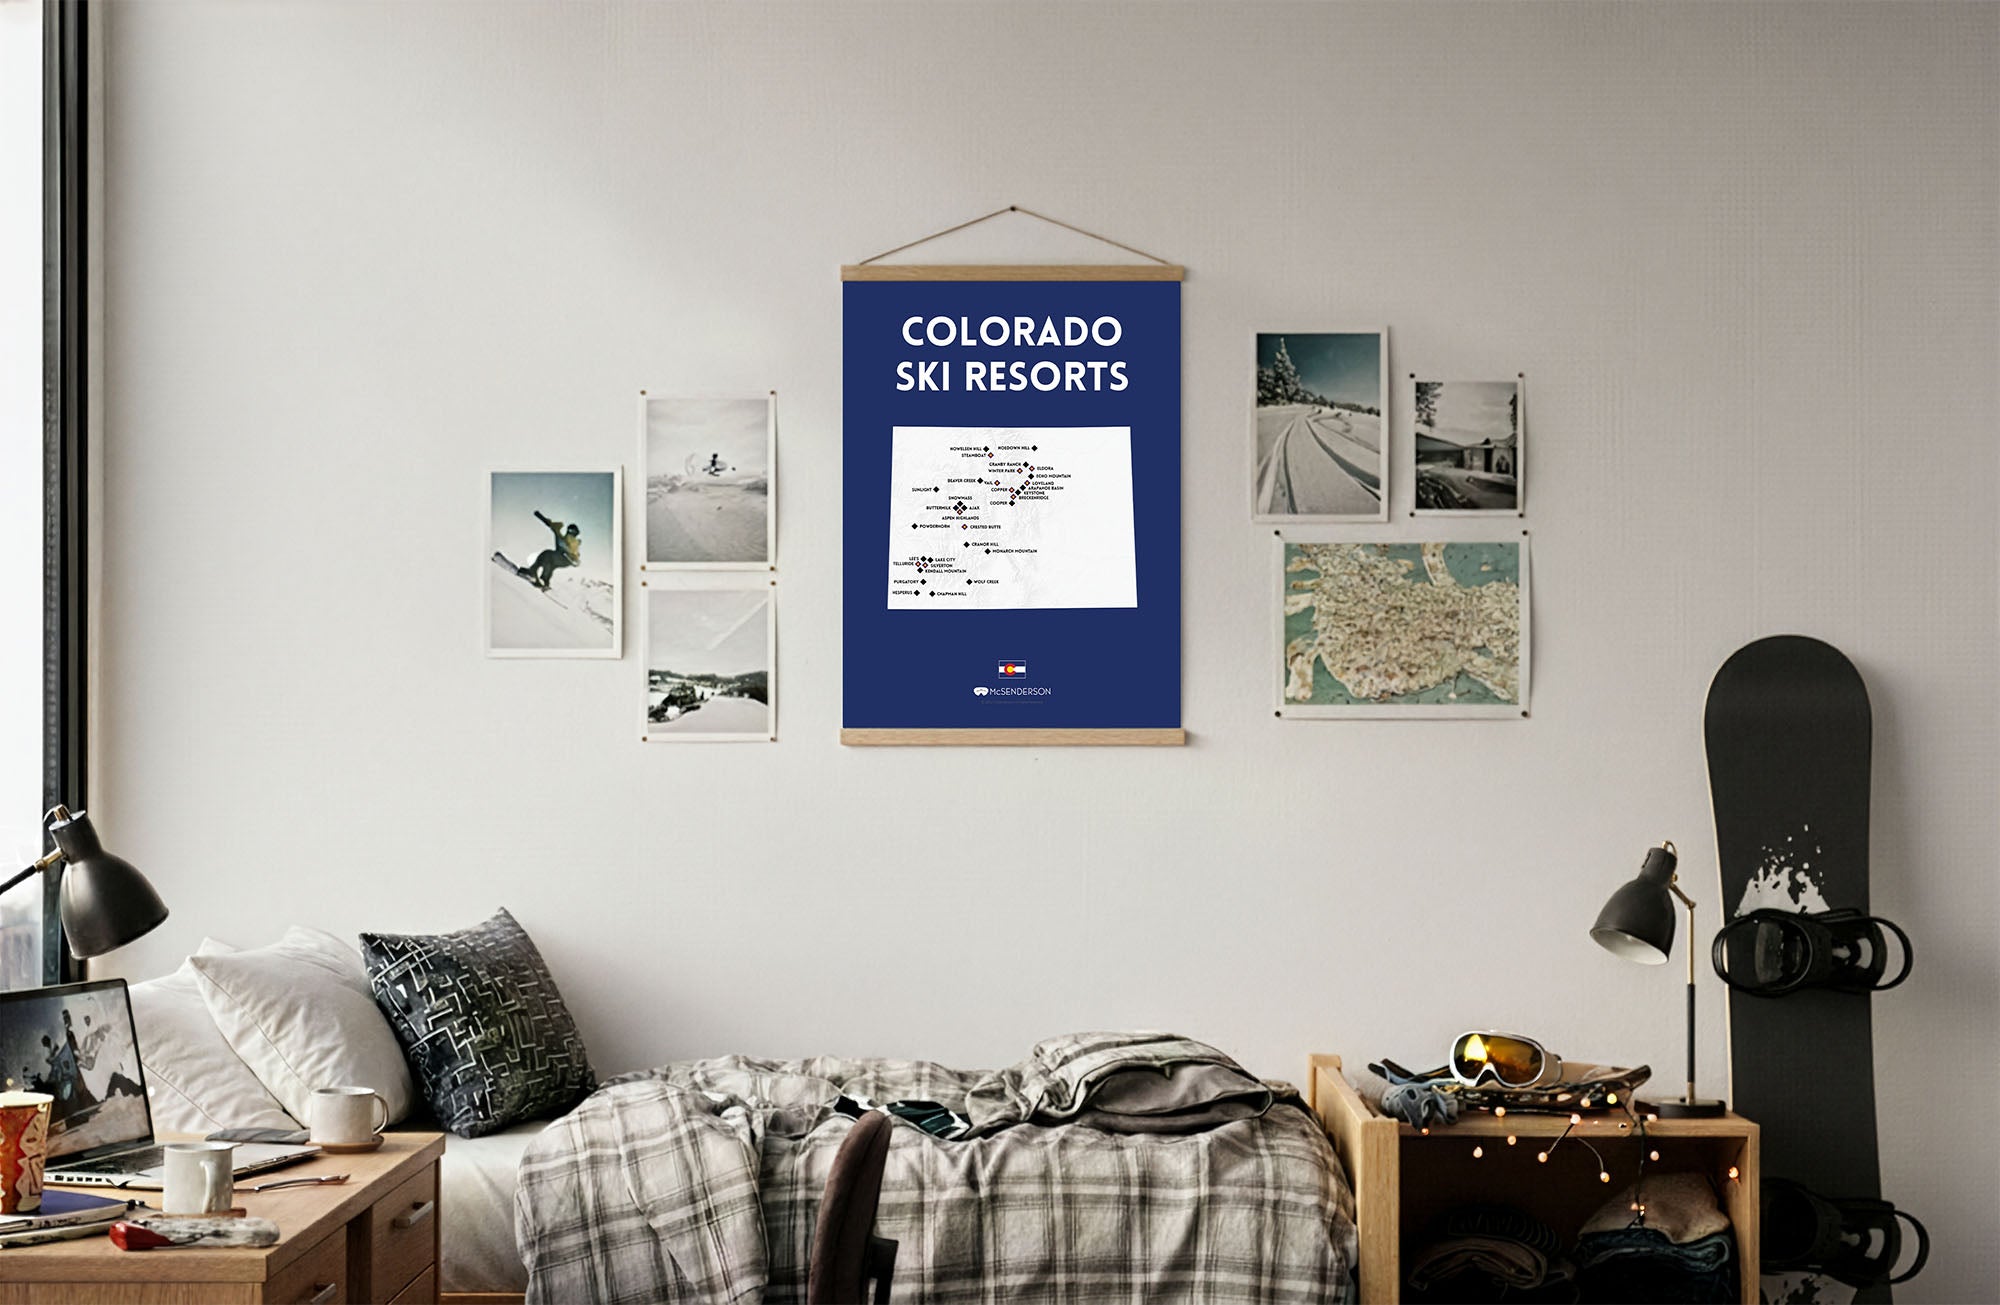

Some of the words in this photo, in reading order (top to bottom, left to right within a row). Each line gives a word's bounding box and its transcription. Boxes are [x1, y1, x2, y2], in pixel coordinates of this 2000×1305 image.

[902, 316, 1122, 346] COLORADO
[896, 361, 949, 391] SKI
[966, 361, 1128, 391] RESORTS
